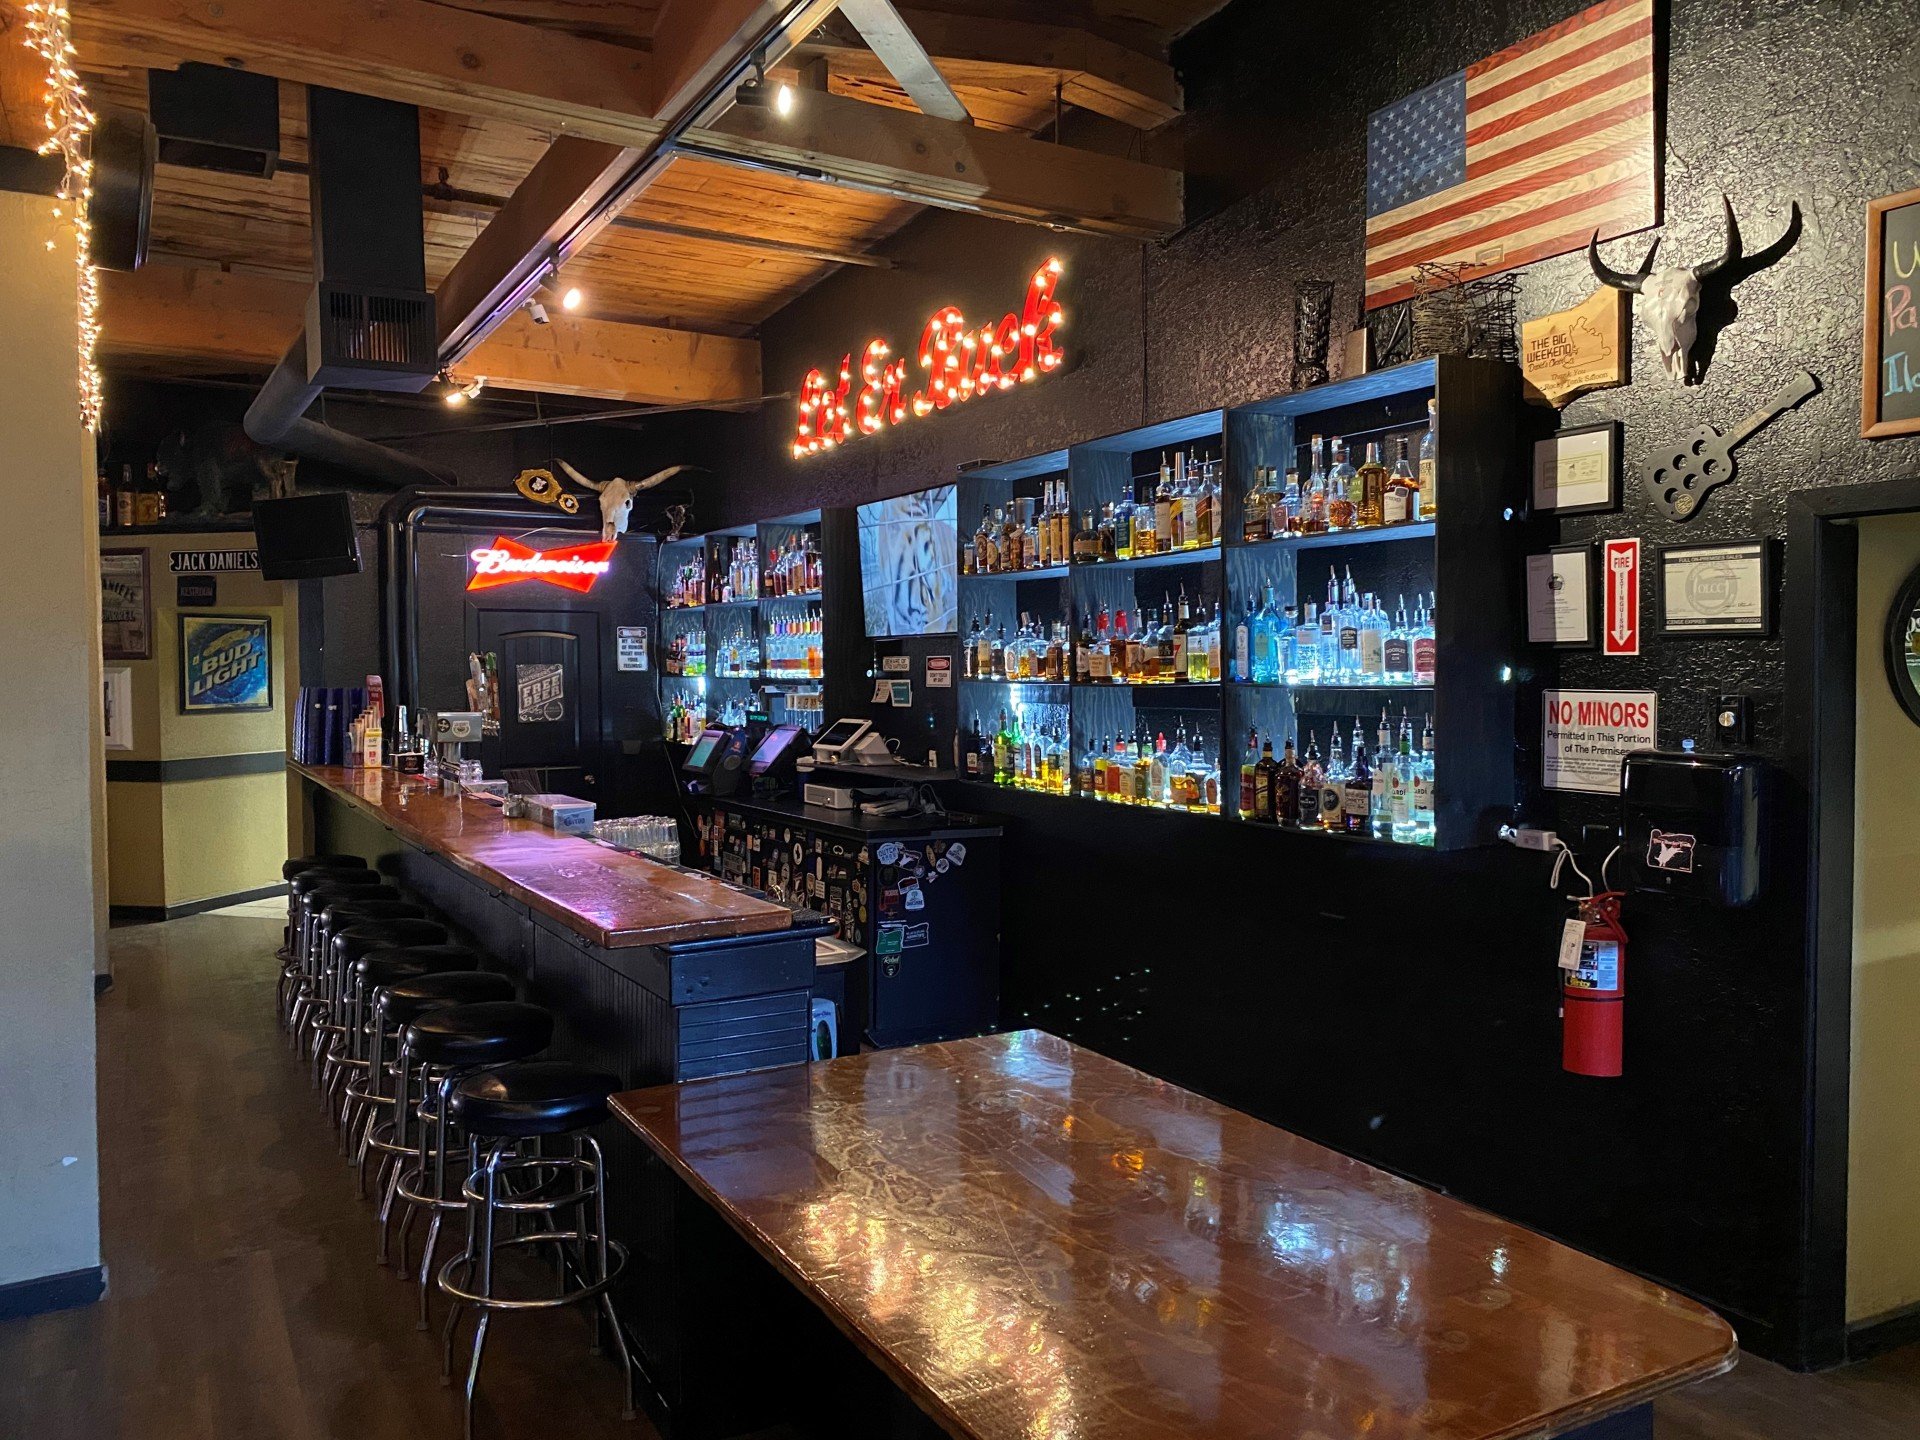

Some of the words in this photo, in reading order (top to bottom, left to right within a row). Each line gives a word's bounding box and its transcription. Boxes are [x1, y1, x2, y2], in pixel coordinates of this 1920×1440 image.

[1531, 337, 1550, 351] THE
[1552, 333, 1567, 346] BIG
[793, 353, 851, 460] Let
[912, 256, 1065, 417] Buck
[1526, 343, 1573, 363] WEEKEND
[1551, 371, 1572, 381] Thank
[1573, 369, 1587, 377] You
[1584, 372, 1609, 381] Saloon
[174, 552, 207, 571] JACK
[209, 551, 259, 570] DANIEL'S
[470, 548, 610, 574] Budweiser
[1613, 556, 1631, 569] FIRE
[1697, 583, 1727, 594] OLCC
[201, 641, 253, 676] BUD
[193, 652, 261, 697] LIGHT
[522, 674, 560, 699] FREE
[523, 686, 560, 709] BEER
[1549, 700, 1573, 725] NO
[1578, 701, 1649, 729] MINORS
[1547, 729, 1586, 741] Permitted
[1587, 732, 1595, 741] in
[1597, 732, 1615, 743] This
[1617, 733, 1651, 744] Portion
[1564, 744, 1573, 754] of
[1575, 744, 1590, 754] The
